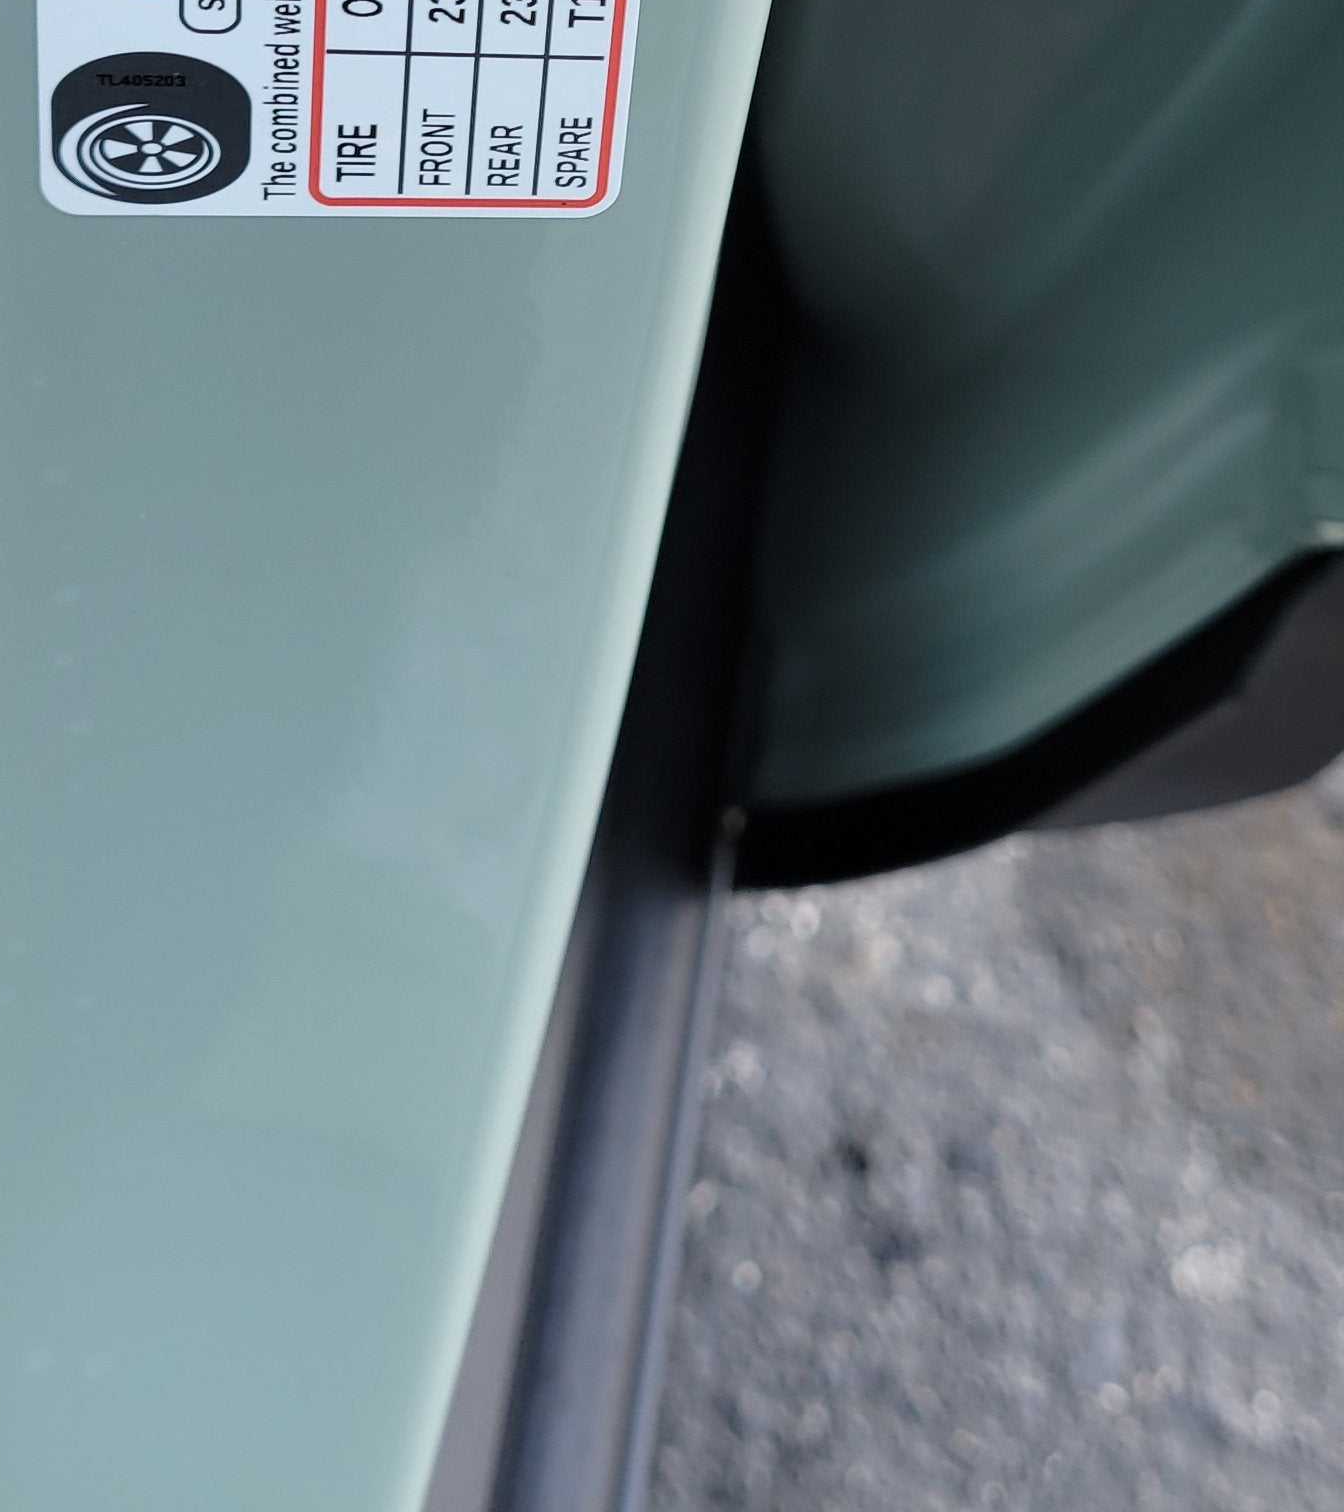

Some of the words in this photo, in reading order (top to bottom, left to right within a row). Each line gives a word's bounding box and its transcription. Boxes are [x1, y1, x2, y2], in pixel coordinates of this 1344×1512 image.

[97, 74, 187, 87] TL405203
[263, 43, 301, 154] combined
[335, 124, 378, 183] TIRE
[418, 108, 455, 186] FRONT
[486, 125, 524, 187] REAR
[554, 117, 593, 188] SPARE
[261, 161, 297, 201] The
